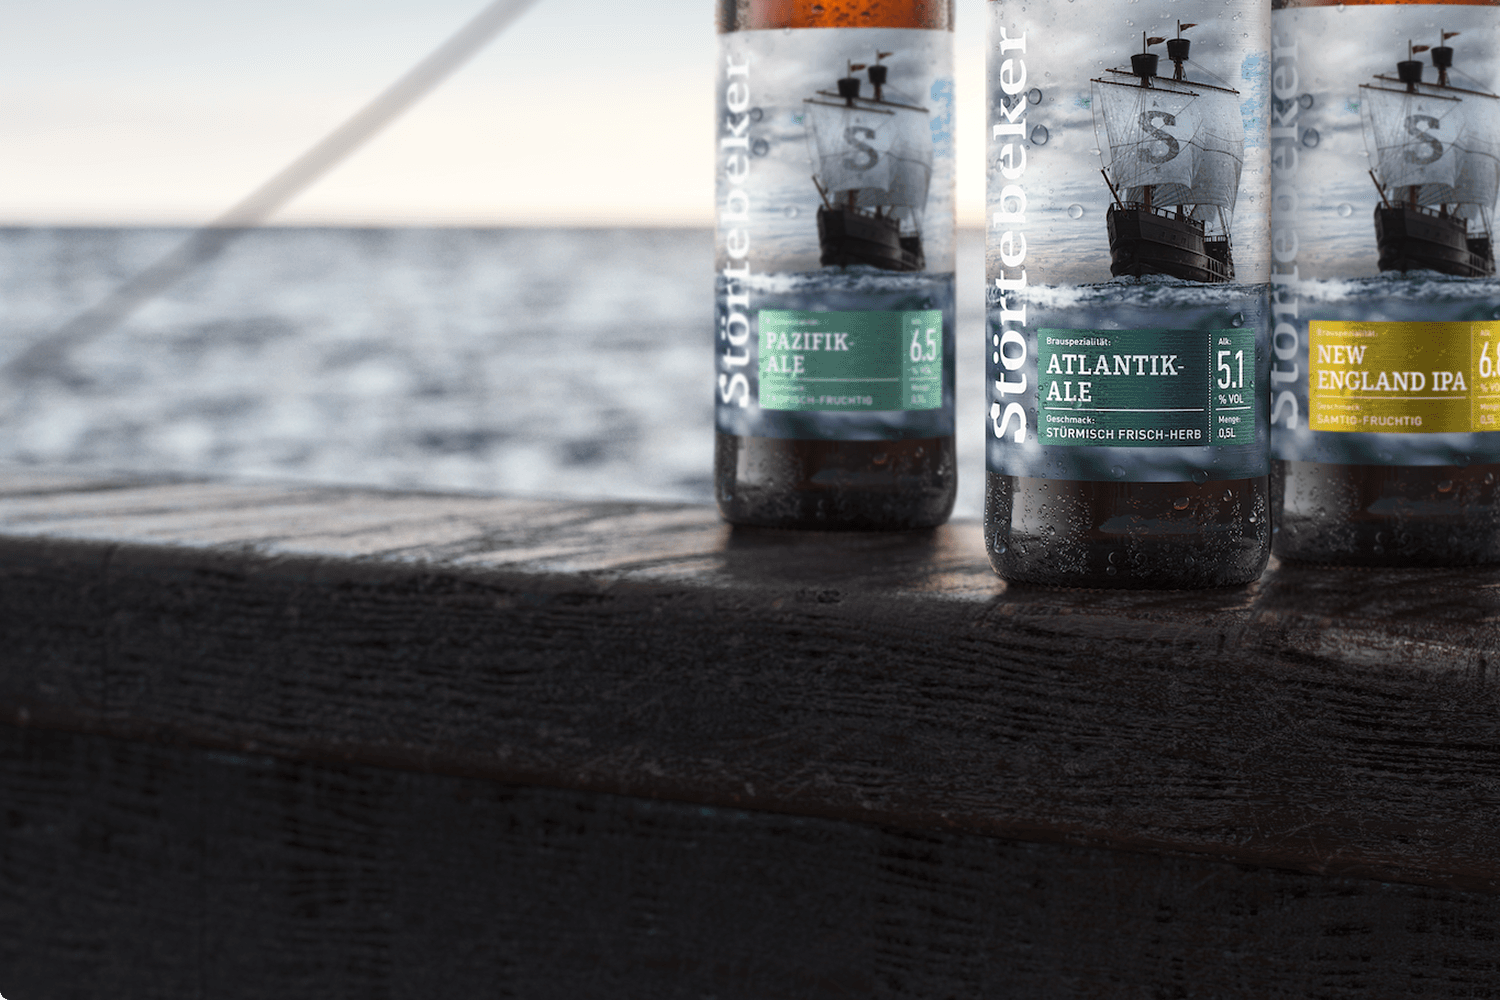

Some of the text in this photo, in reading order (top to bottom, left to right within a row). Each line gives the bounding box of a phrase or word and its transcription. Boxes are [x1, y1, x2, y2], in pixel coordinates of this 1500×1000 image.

[718, 55, 750, 408] Störtebeker
[990, 26, 1027, 444] Störtebeker
[765, 331, 855, 351] PAZIFIK-
[910, 328, 937, 362] 6.5
[1046, 336, 1111, 347] Brauspezialität:
[765, 355, 805, 373] ALE
[1046, 353, 1185, 376] ATLANTIK-
[1317, 344, 1367, 365] NEW
[1217, 350, 1243, 389] 5.1
[1317, 370, 1467, 391] ENGLAND IPA
[1046, 381, 1092, 402] ALE
[1218, 393, 1244, 404] % VOL
[1046, 415, 1096, 424] Geschmack:
[1317, 414, 1422, 426] SAMTIG-FRUCHTIG
[1046, 426, 1202, 440] STÜRMISCH FRISCH-HERB
[1218, 427, 1236, 439] 0,5L
